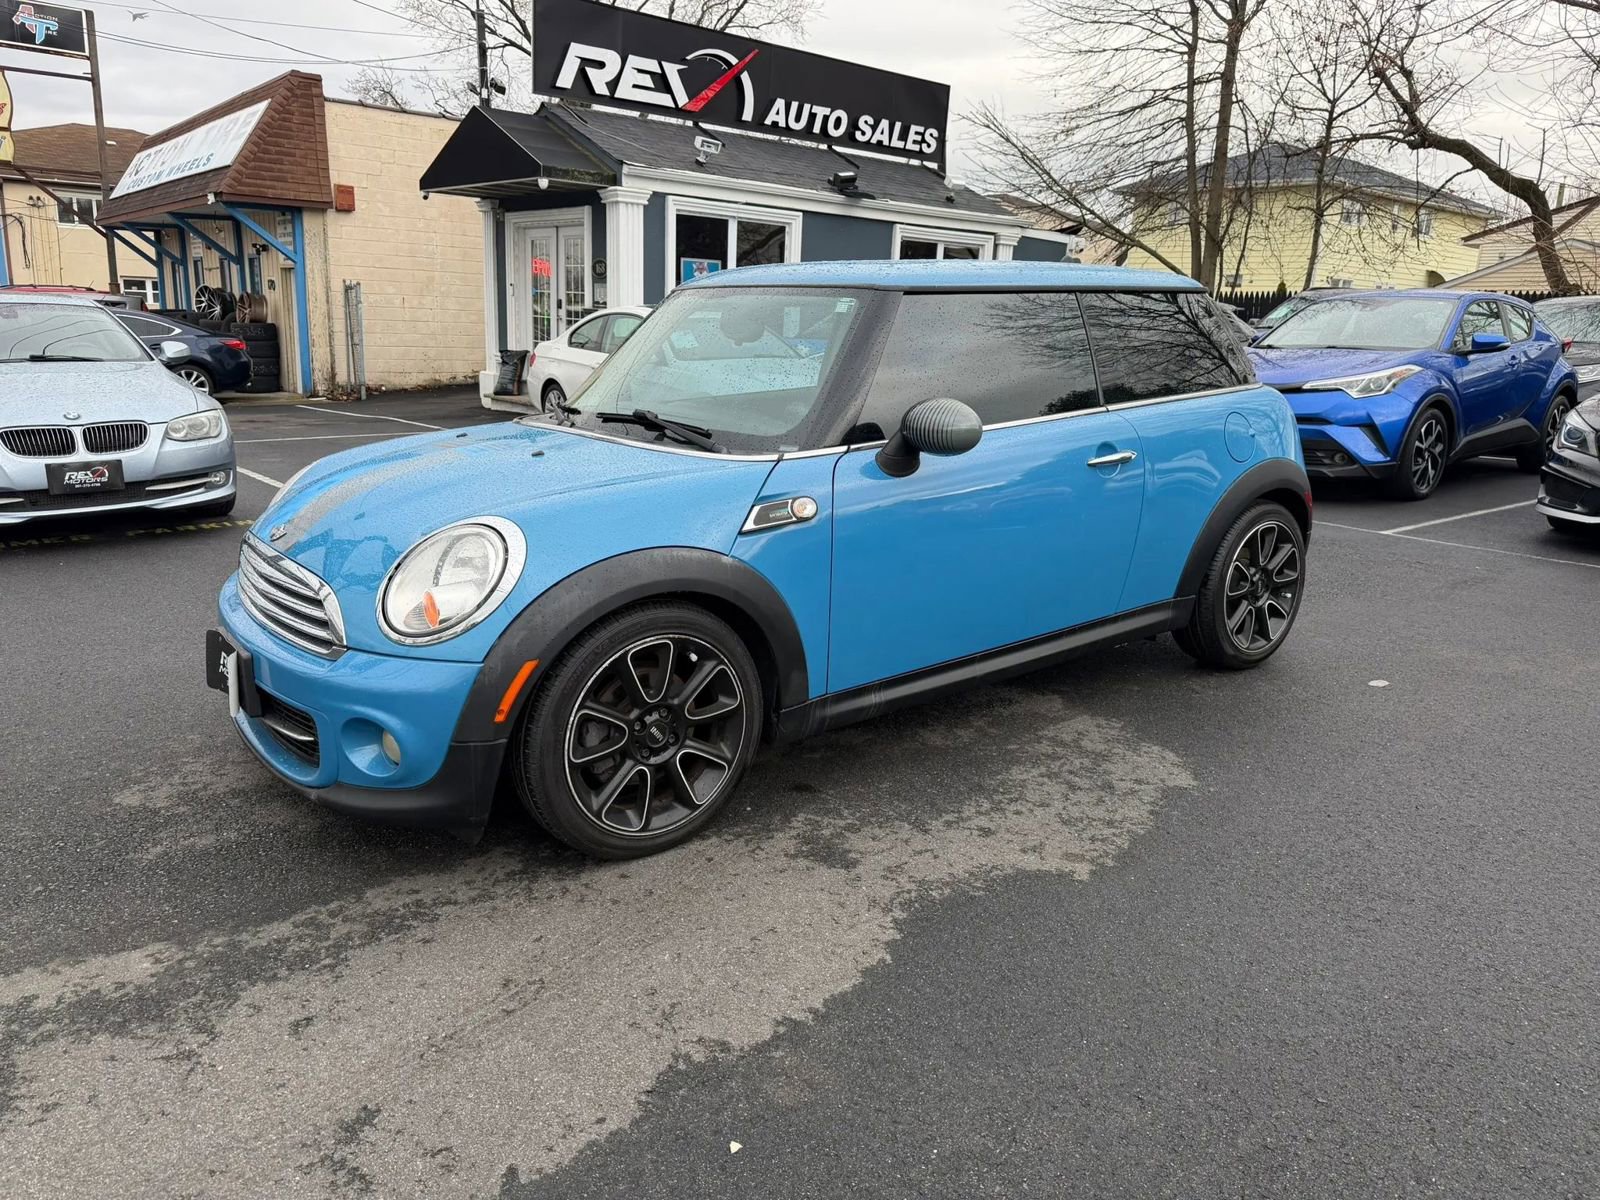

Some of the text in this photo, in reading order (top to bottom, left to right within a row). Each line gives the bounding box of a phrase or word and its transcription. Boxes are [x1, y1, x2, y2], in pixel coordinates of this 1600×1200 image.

[764, 98, 938, 154] AUTO SALES
[127, 153, 214, 190] CUSTOM WHEELS
[64, 476, 108, 484] MOTORS
[650, 726, 663, 742] MINI
